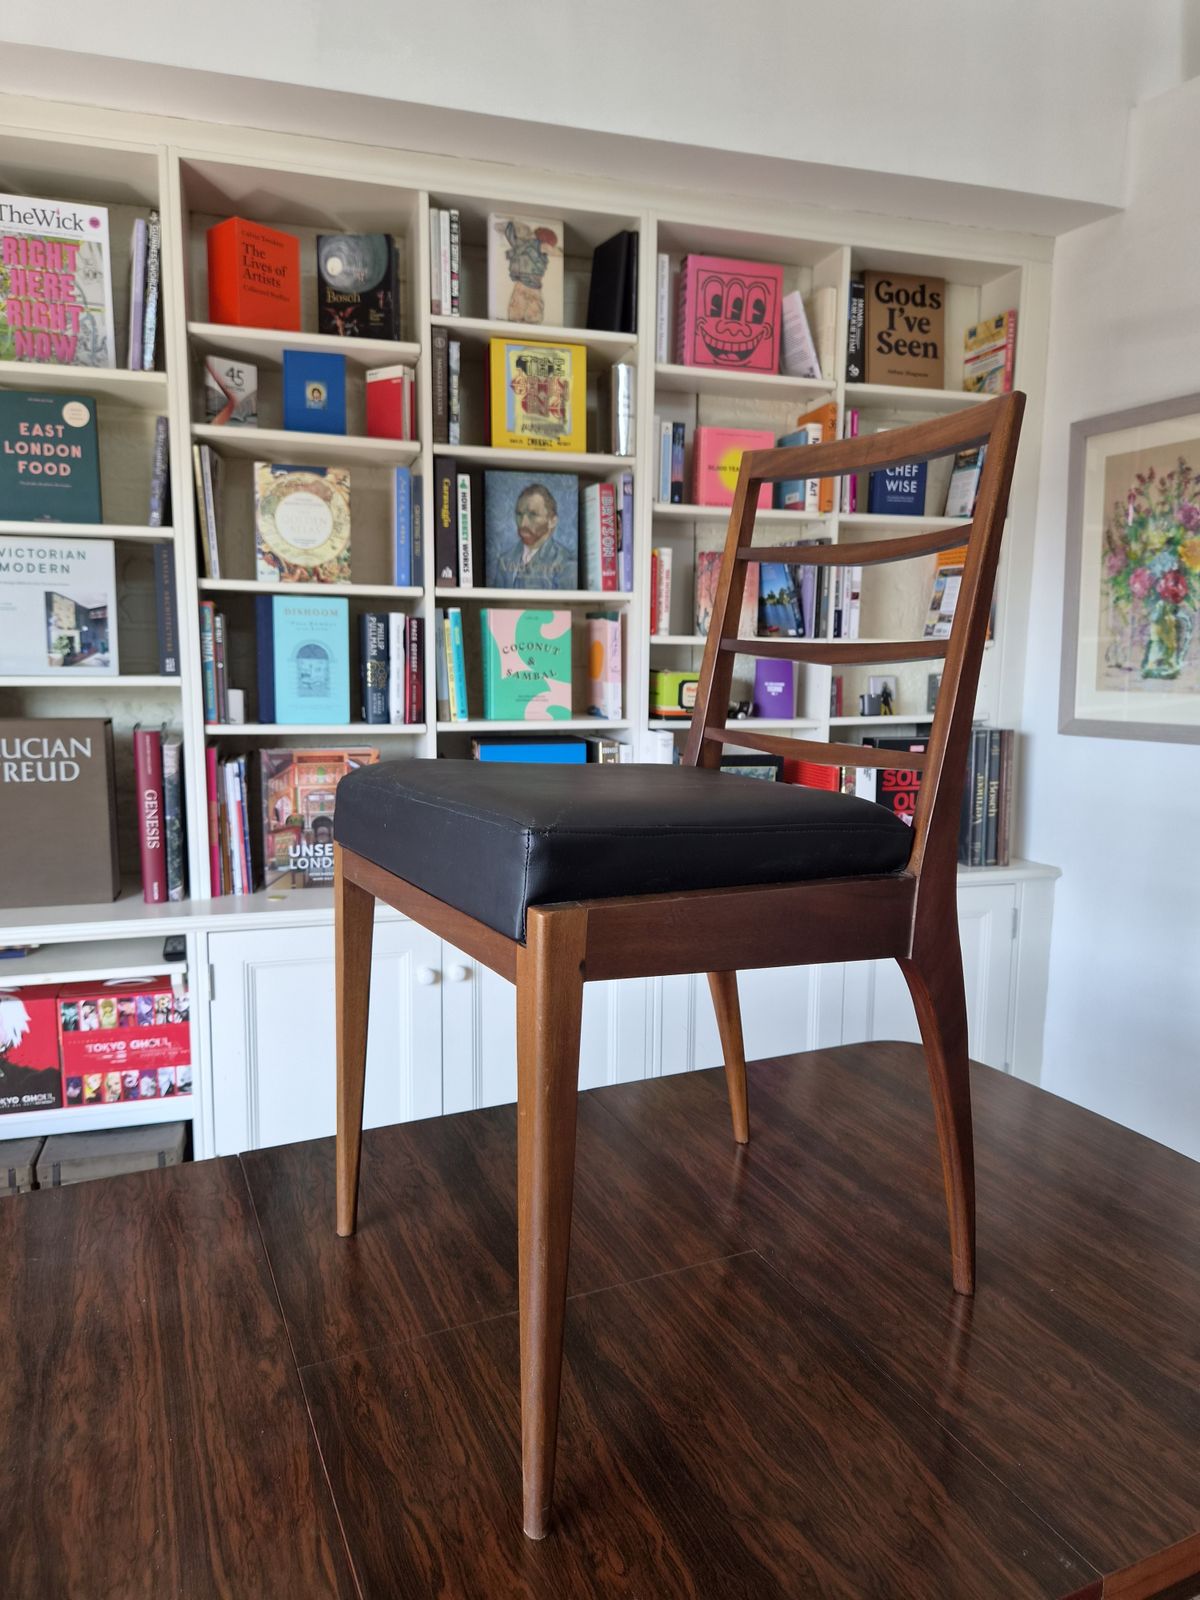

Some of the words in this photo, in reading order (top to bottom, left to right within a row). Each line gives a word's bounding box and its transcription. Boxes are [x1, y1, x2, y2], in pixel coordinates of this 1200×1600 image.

[3, 236, 80, 272] RIGHT
[242, 241, 266, 260] The
[243, 256, 272, 273] Lives
[275, 265, 287, 277] of
[8, 268, 76, 302] HERE
[243, 269, 281, 288] Artists
[327, 290, 361, 304] Bosch
[874, 280, 942, 310] Gods
[6, 298, 84, 333] RIGHT
[887, 307, 932, 333] I've
[14, 329, 78, 363] NOW
[876, 331, 939, 359] Seen
[19, 422, 65, 438] EAST
[4, 440, 82, 459] LONDON
[17, 460, 71, 476] FOOD
[885, 480, 918, 493] WISE
[441, 478, 451, 528] Caravaggio
[602, 496, 614, 558] BRYSON
[0, 548, 87, 561] VICTORIAN
[0, 562, 71, 574] MODERN
[284, 607, 339, 617] DISHOOM
[368, 616, 377, 656] PULLMAN
[377, 623, 385, 650] PHILIP
[502, 641, 561, 655] COCONUT
[527, 657, 535, 666] &
[506, 668, 557, 681] SAMBAL
[0, 737, 92, 759] UCIAN
[0, 760, 81, 782] REUD
[988, 781, 998, 816] Bosch
[145, 789, 160, 849] GENESIS
[288, 843, 334, 858] UNSE
[290, 856, 334, 870] LOND
[85, 1041, 126, 1053] TOKYO
[130, 1037, 172, 1050] GHOUL
[22, 1093, 56, 1103] GHOUL
